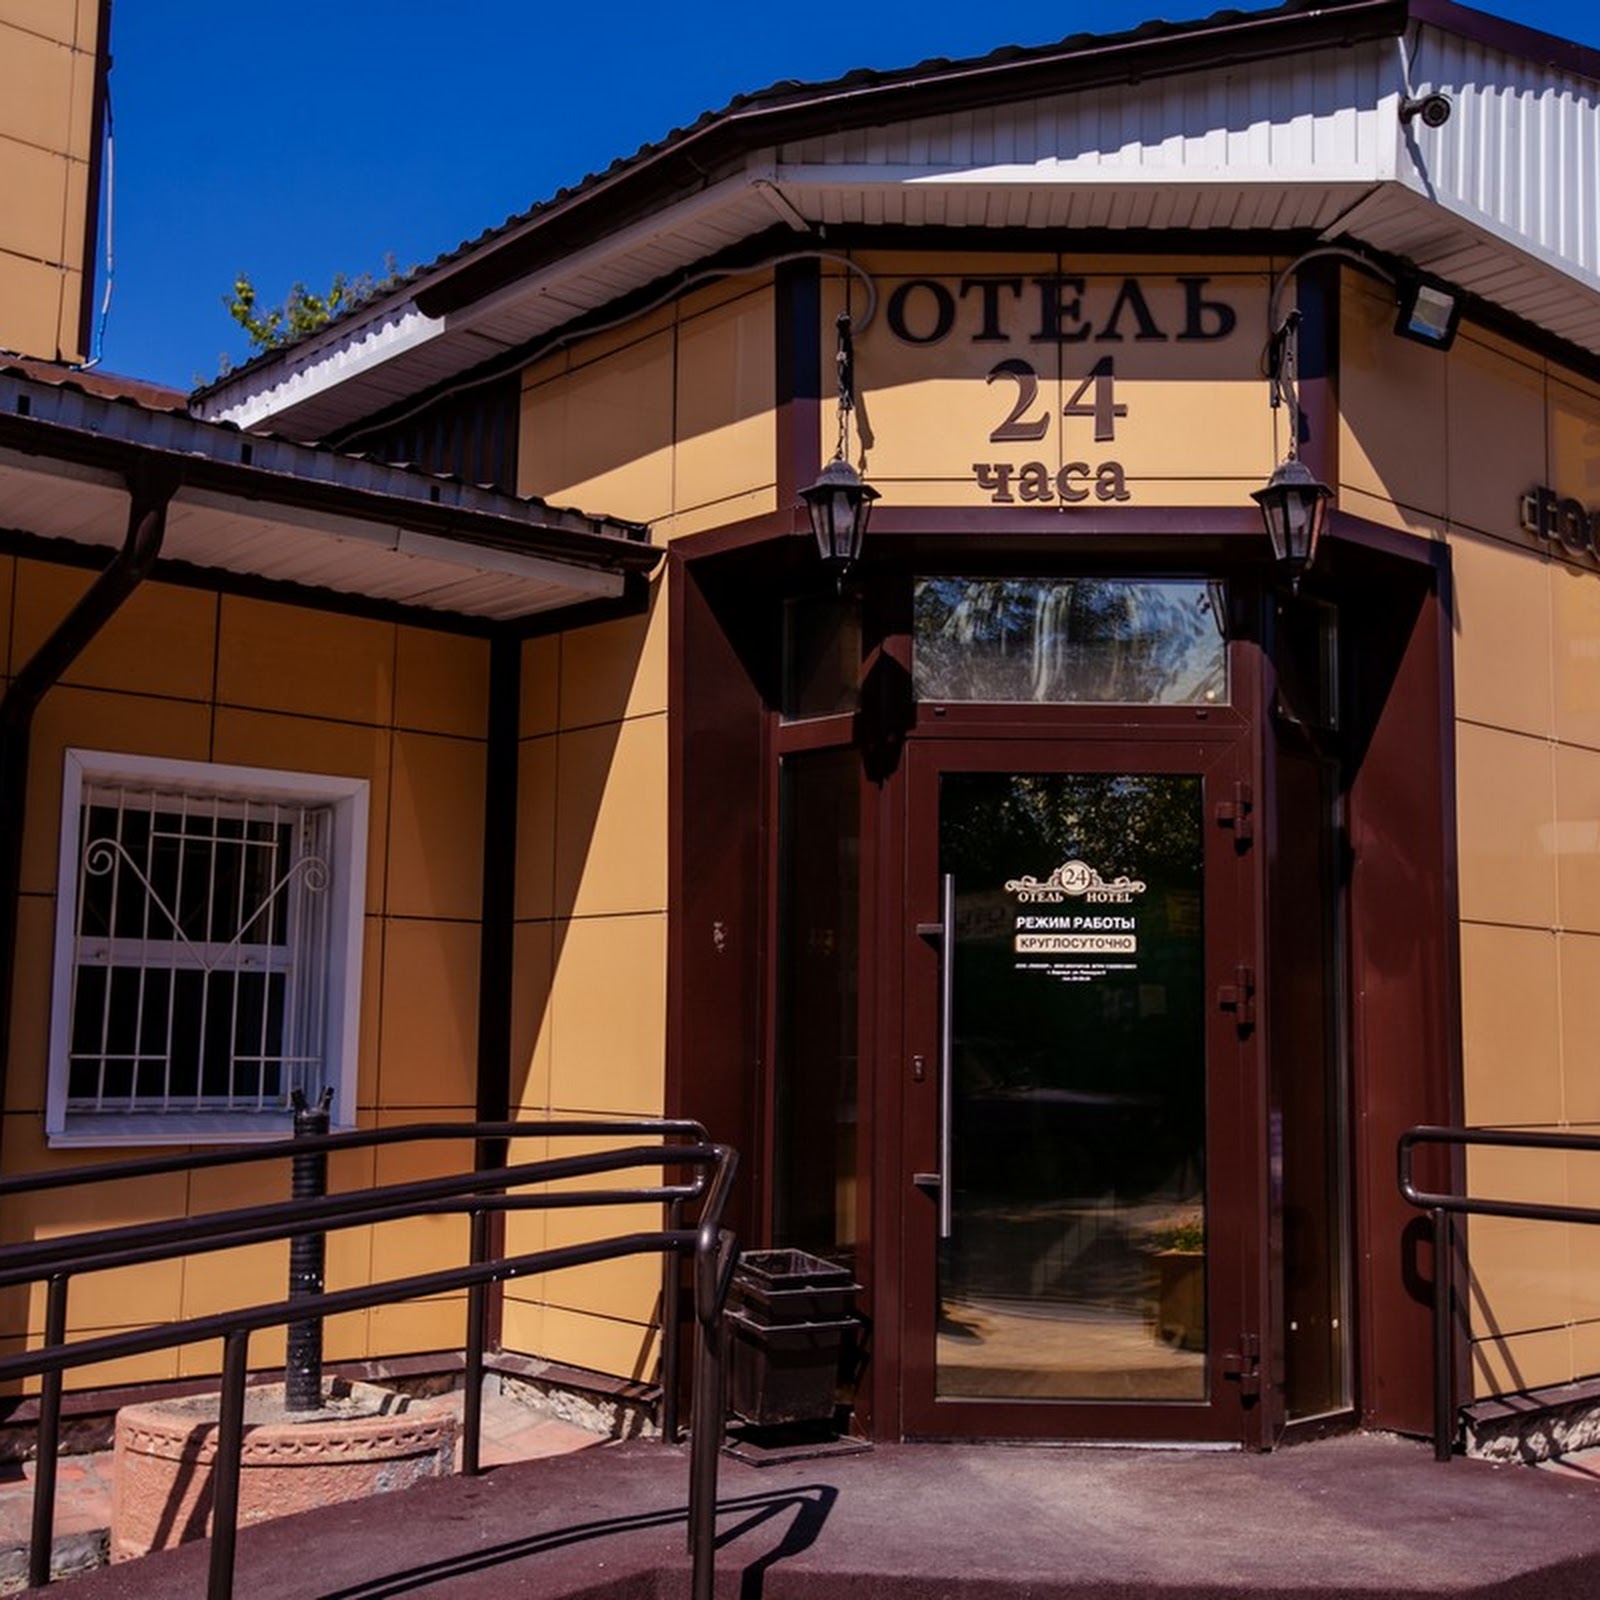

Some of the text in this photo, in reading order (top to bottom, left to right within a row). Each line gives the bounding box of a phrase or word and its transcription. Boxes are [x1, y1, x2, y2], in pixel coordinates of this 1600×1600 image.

[886, 276, 1237, 346] ОТЕЛЬ
[985, 355, 1129, 443] 24
[972, 459, 1132, 504] часа
[1065, 867, 1088, 886] 24
[1017, 891, 1133, 903] ОТЕЛЬ HOTEL
[1015, 916, 1136, 930] РЕЖИМ РАБОТЫ
[1020, 937, 1132, 950] КРУГЛОСУТОЧНО
